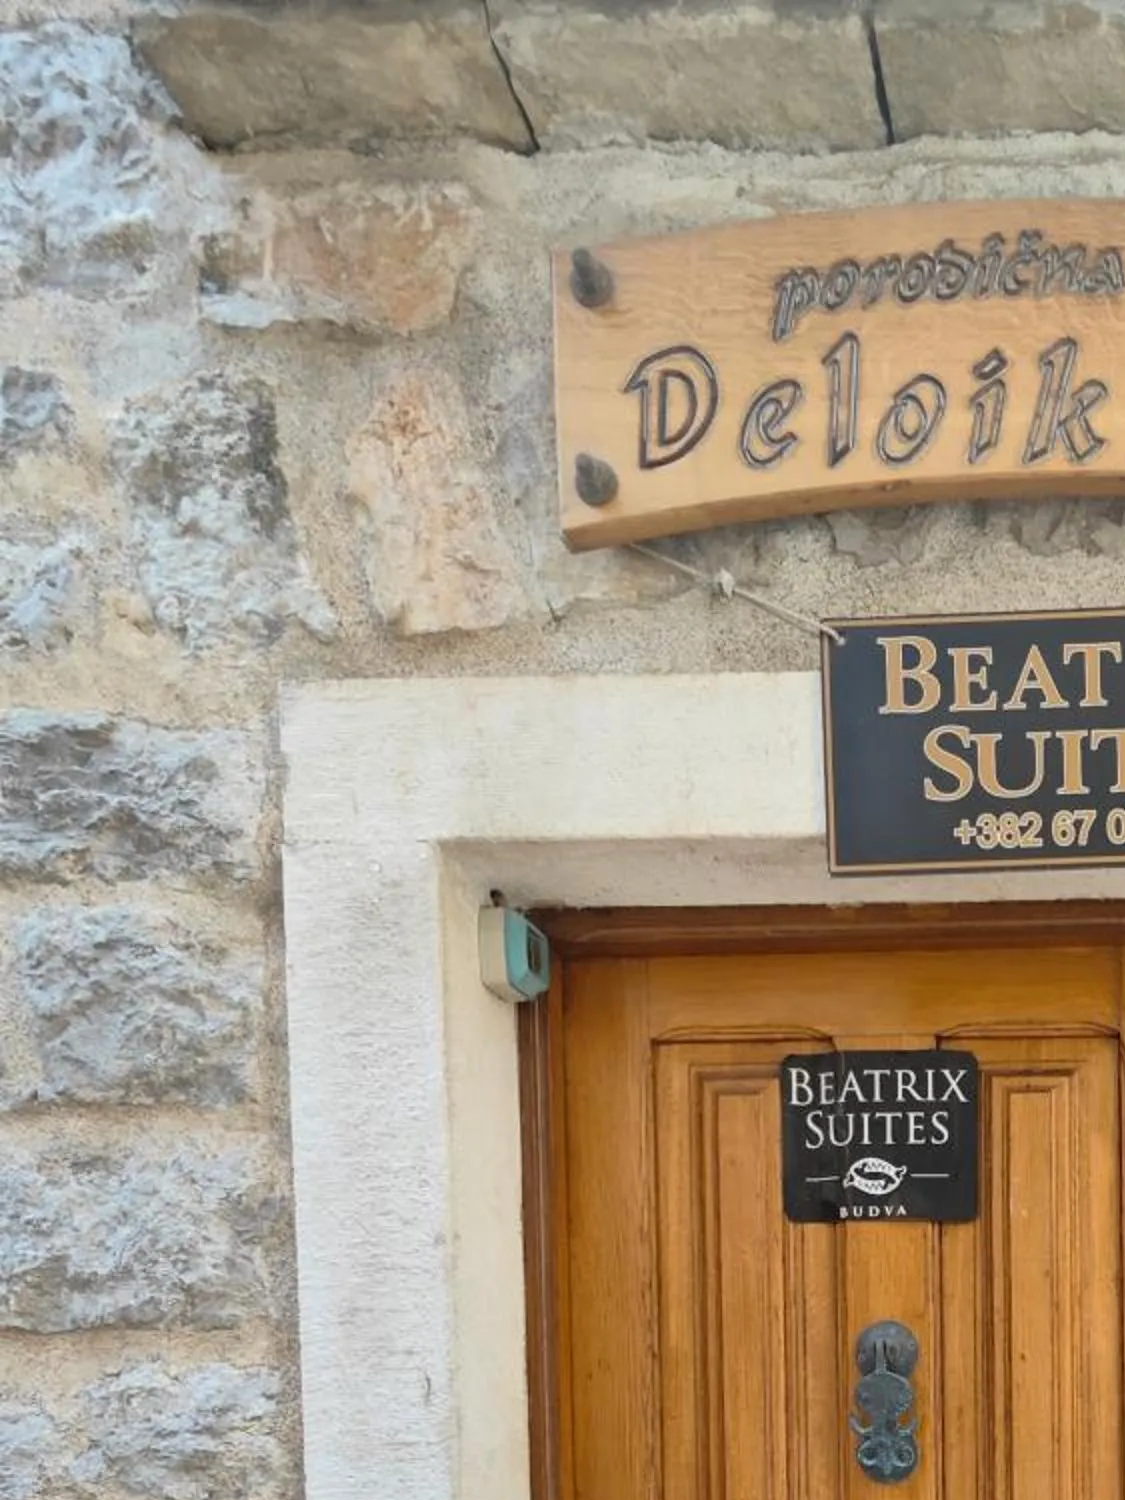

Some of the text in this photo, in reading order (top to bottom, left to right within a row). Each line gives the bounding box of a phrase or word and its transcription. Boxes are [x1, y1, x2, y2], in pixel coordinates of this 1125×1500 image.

[623, 331, 1110, 469] Deloik
[953, 811, 1044, 850] +382
[1051, 808, 1097, 847] 67
[787, 1067, 970, 1106] BEATRIX
[805, 1109, 950, 1149] SUITES
[839, 1204, 908, 1218] BUDVA
